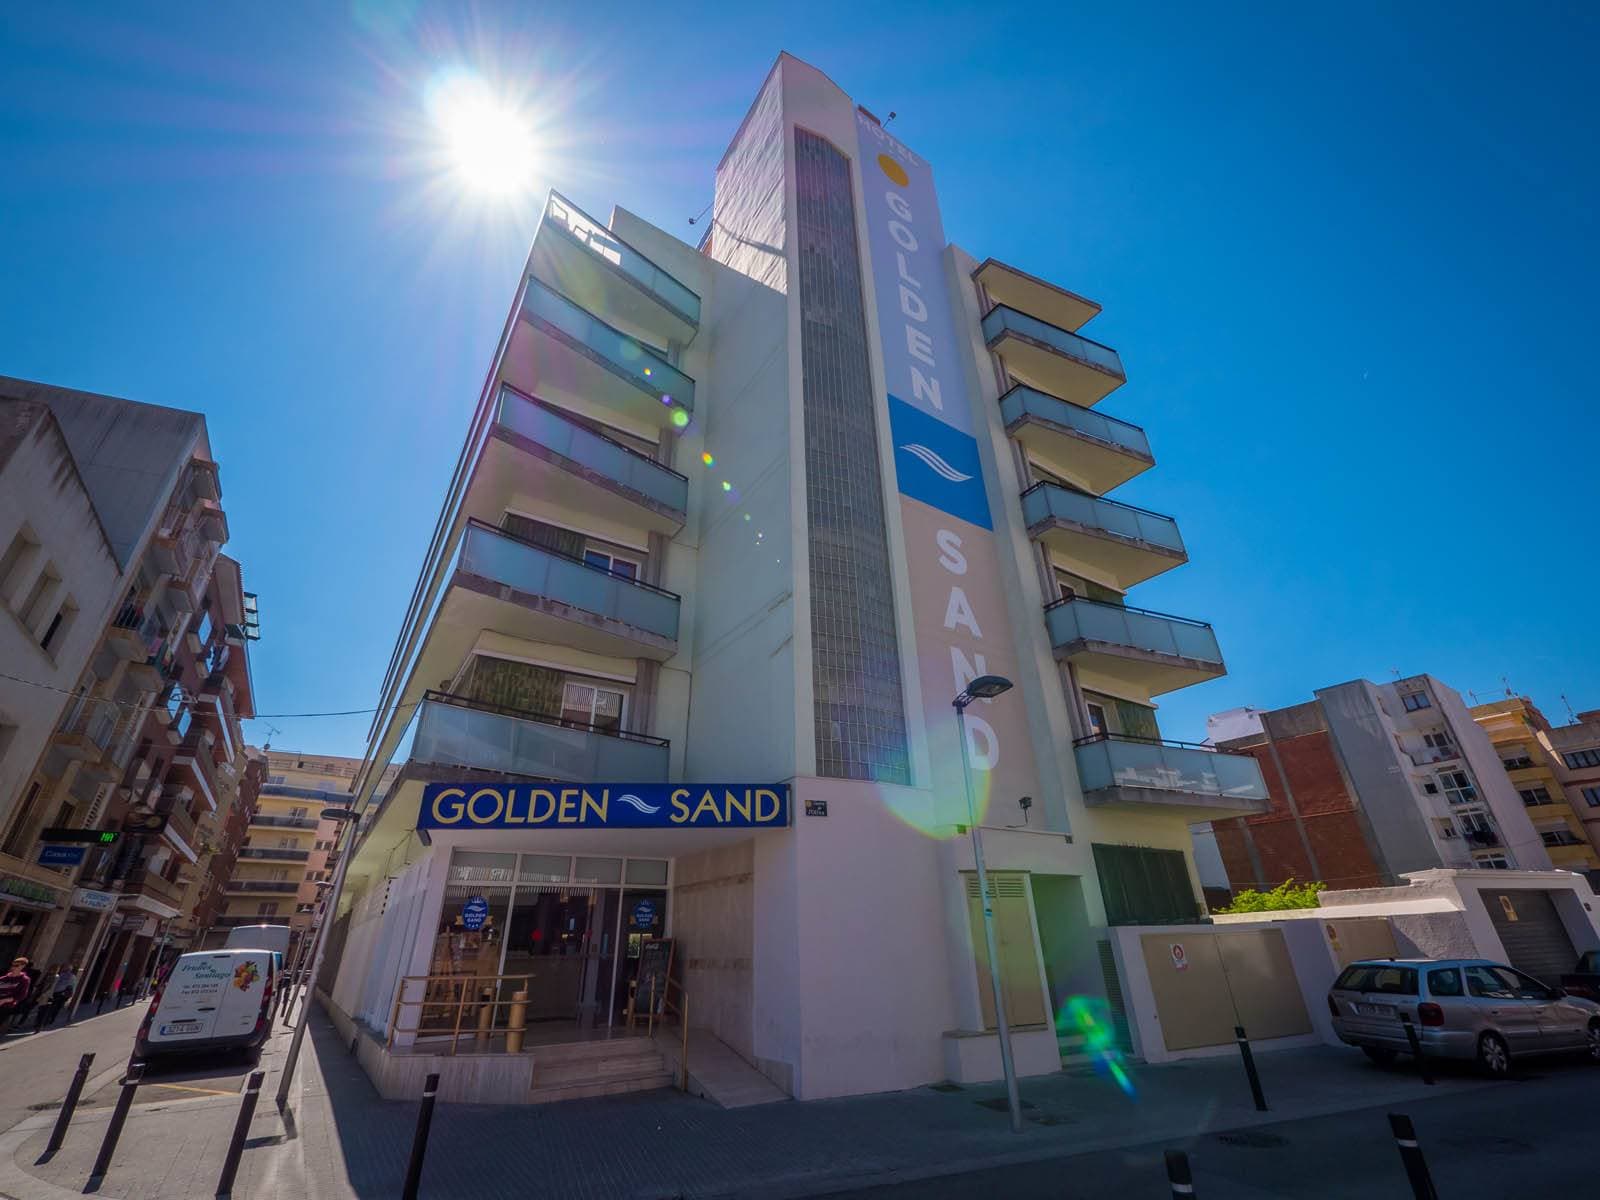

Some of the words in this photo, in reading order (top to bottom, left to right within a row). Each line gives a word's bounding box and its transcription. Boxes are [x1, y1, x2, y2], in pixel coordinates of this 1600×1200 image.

[856, 112, 919, 167] HOTEL
[885, 191, 943, 411] GOLDEN
[936, 528, 999, 770] SAND
[431, 788, 609, 824] GOLDEN
[669, 789, 781, 822] SAND
